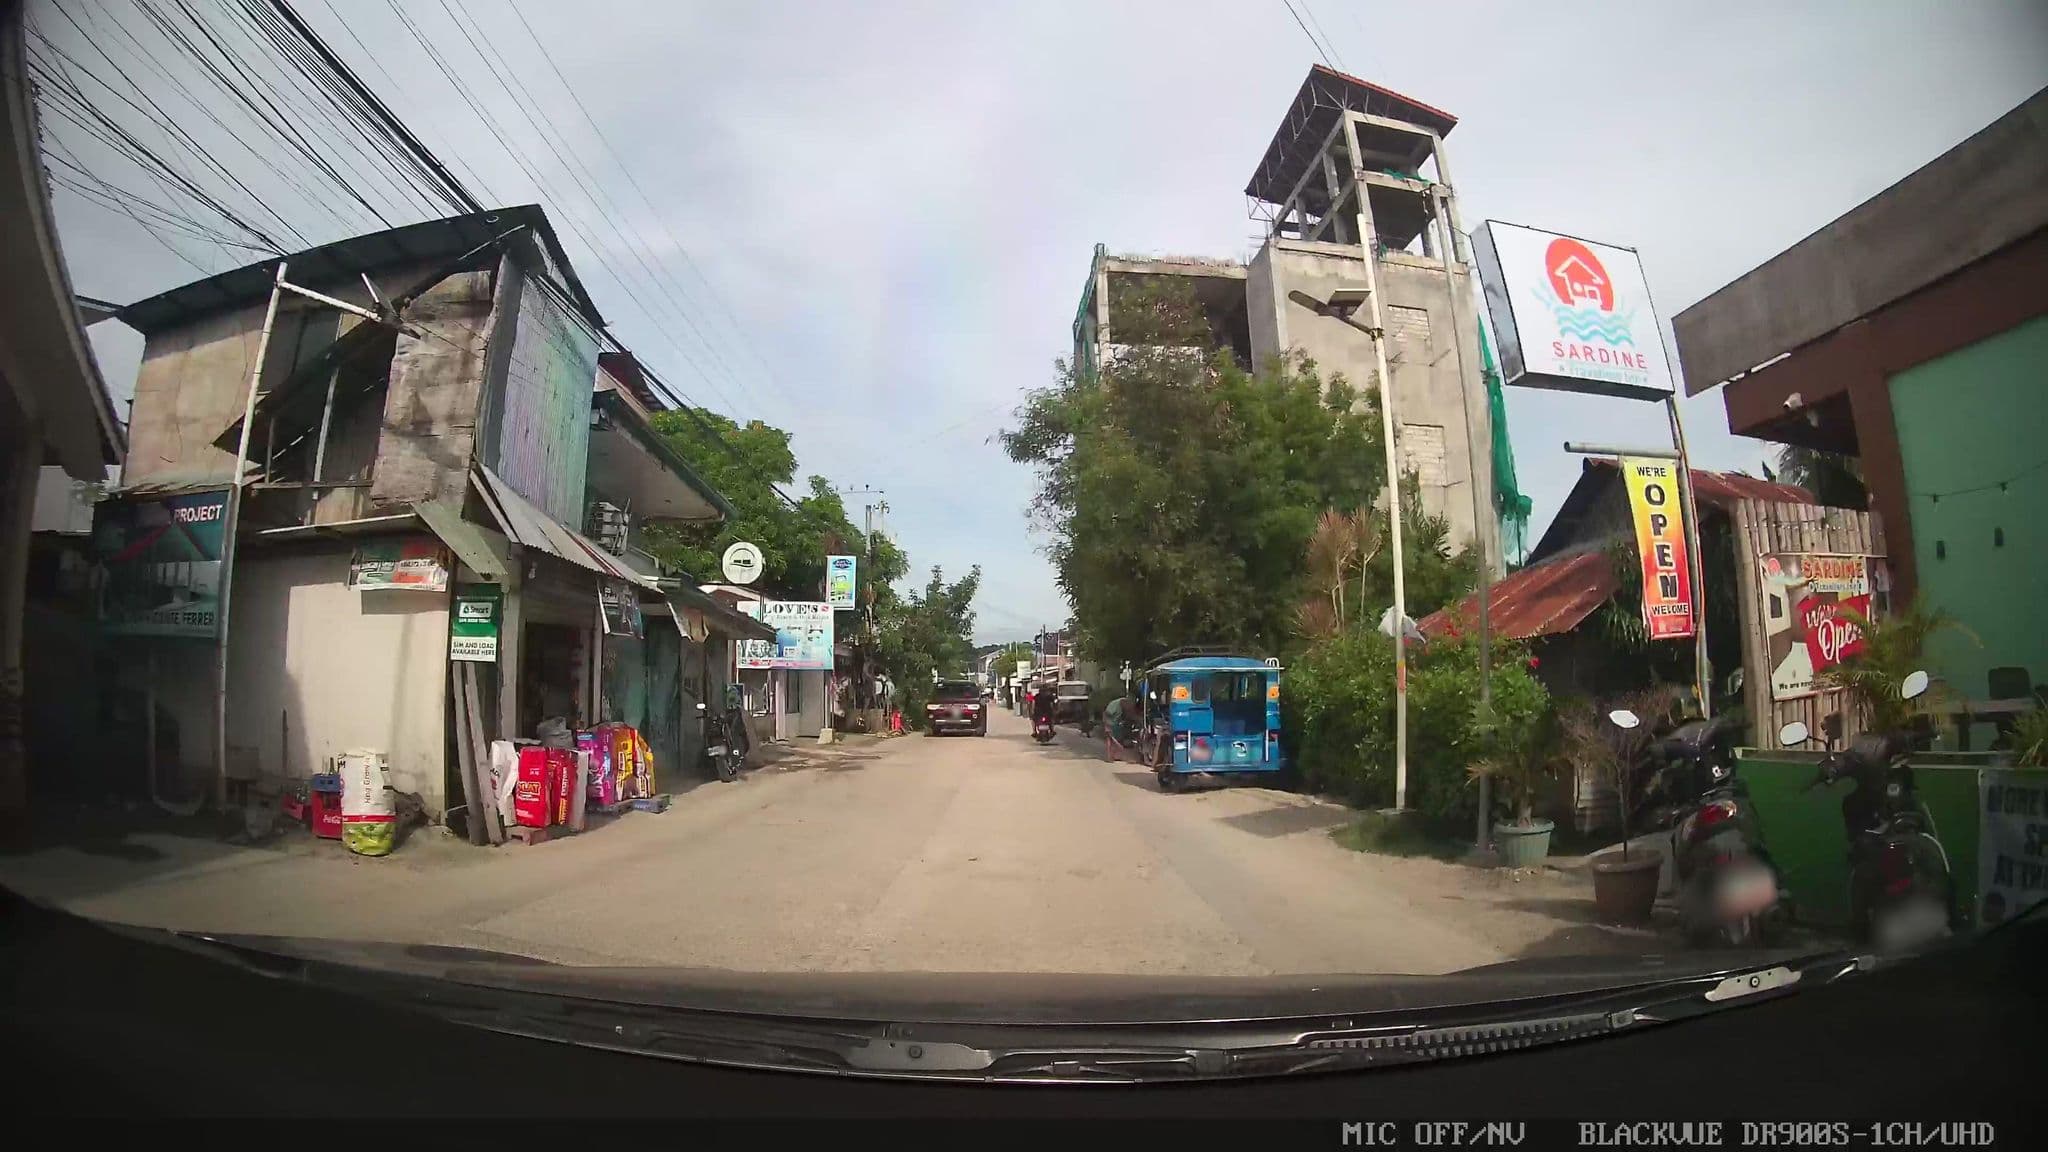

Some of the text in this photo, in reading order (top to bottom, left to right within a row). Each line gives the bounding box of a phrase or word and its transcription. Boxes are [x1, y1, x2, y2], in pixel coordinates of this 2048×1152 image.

[1552, 341, 1647, 369] SARDINE
[1637, 466, 1667, 477] WE'RE
[174, 505, 223, 522] PROJECT
[1644, 483, 1678, 599] OPEN
[1803, 559, 1864, 579] SARDINE
[470, 606, 489, 614] Smart
[764, 603, 819, 615] LOVE'S
